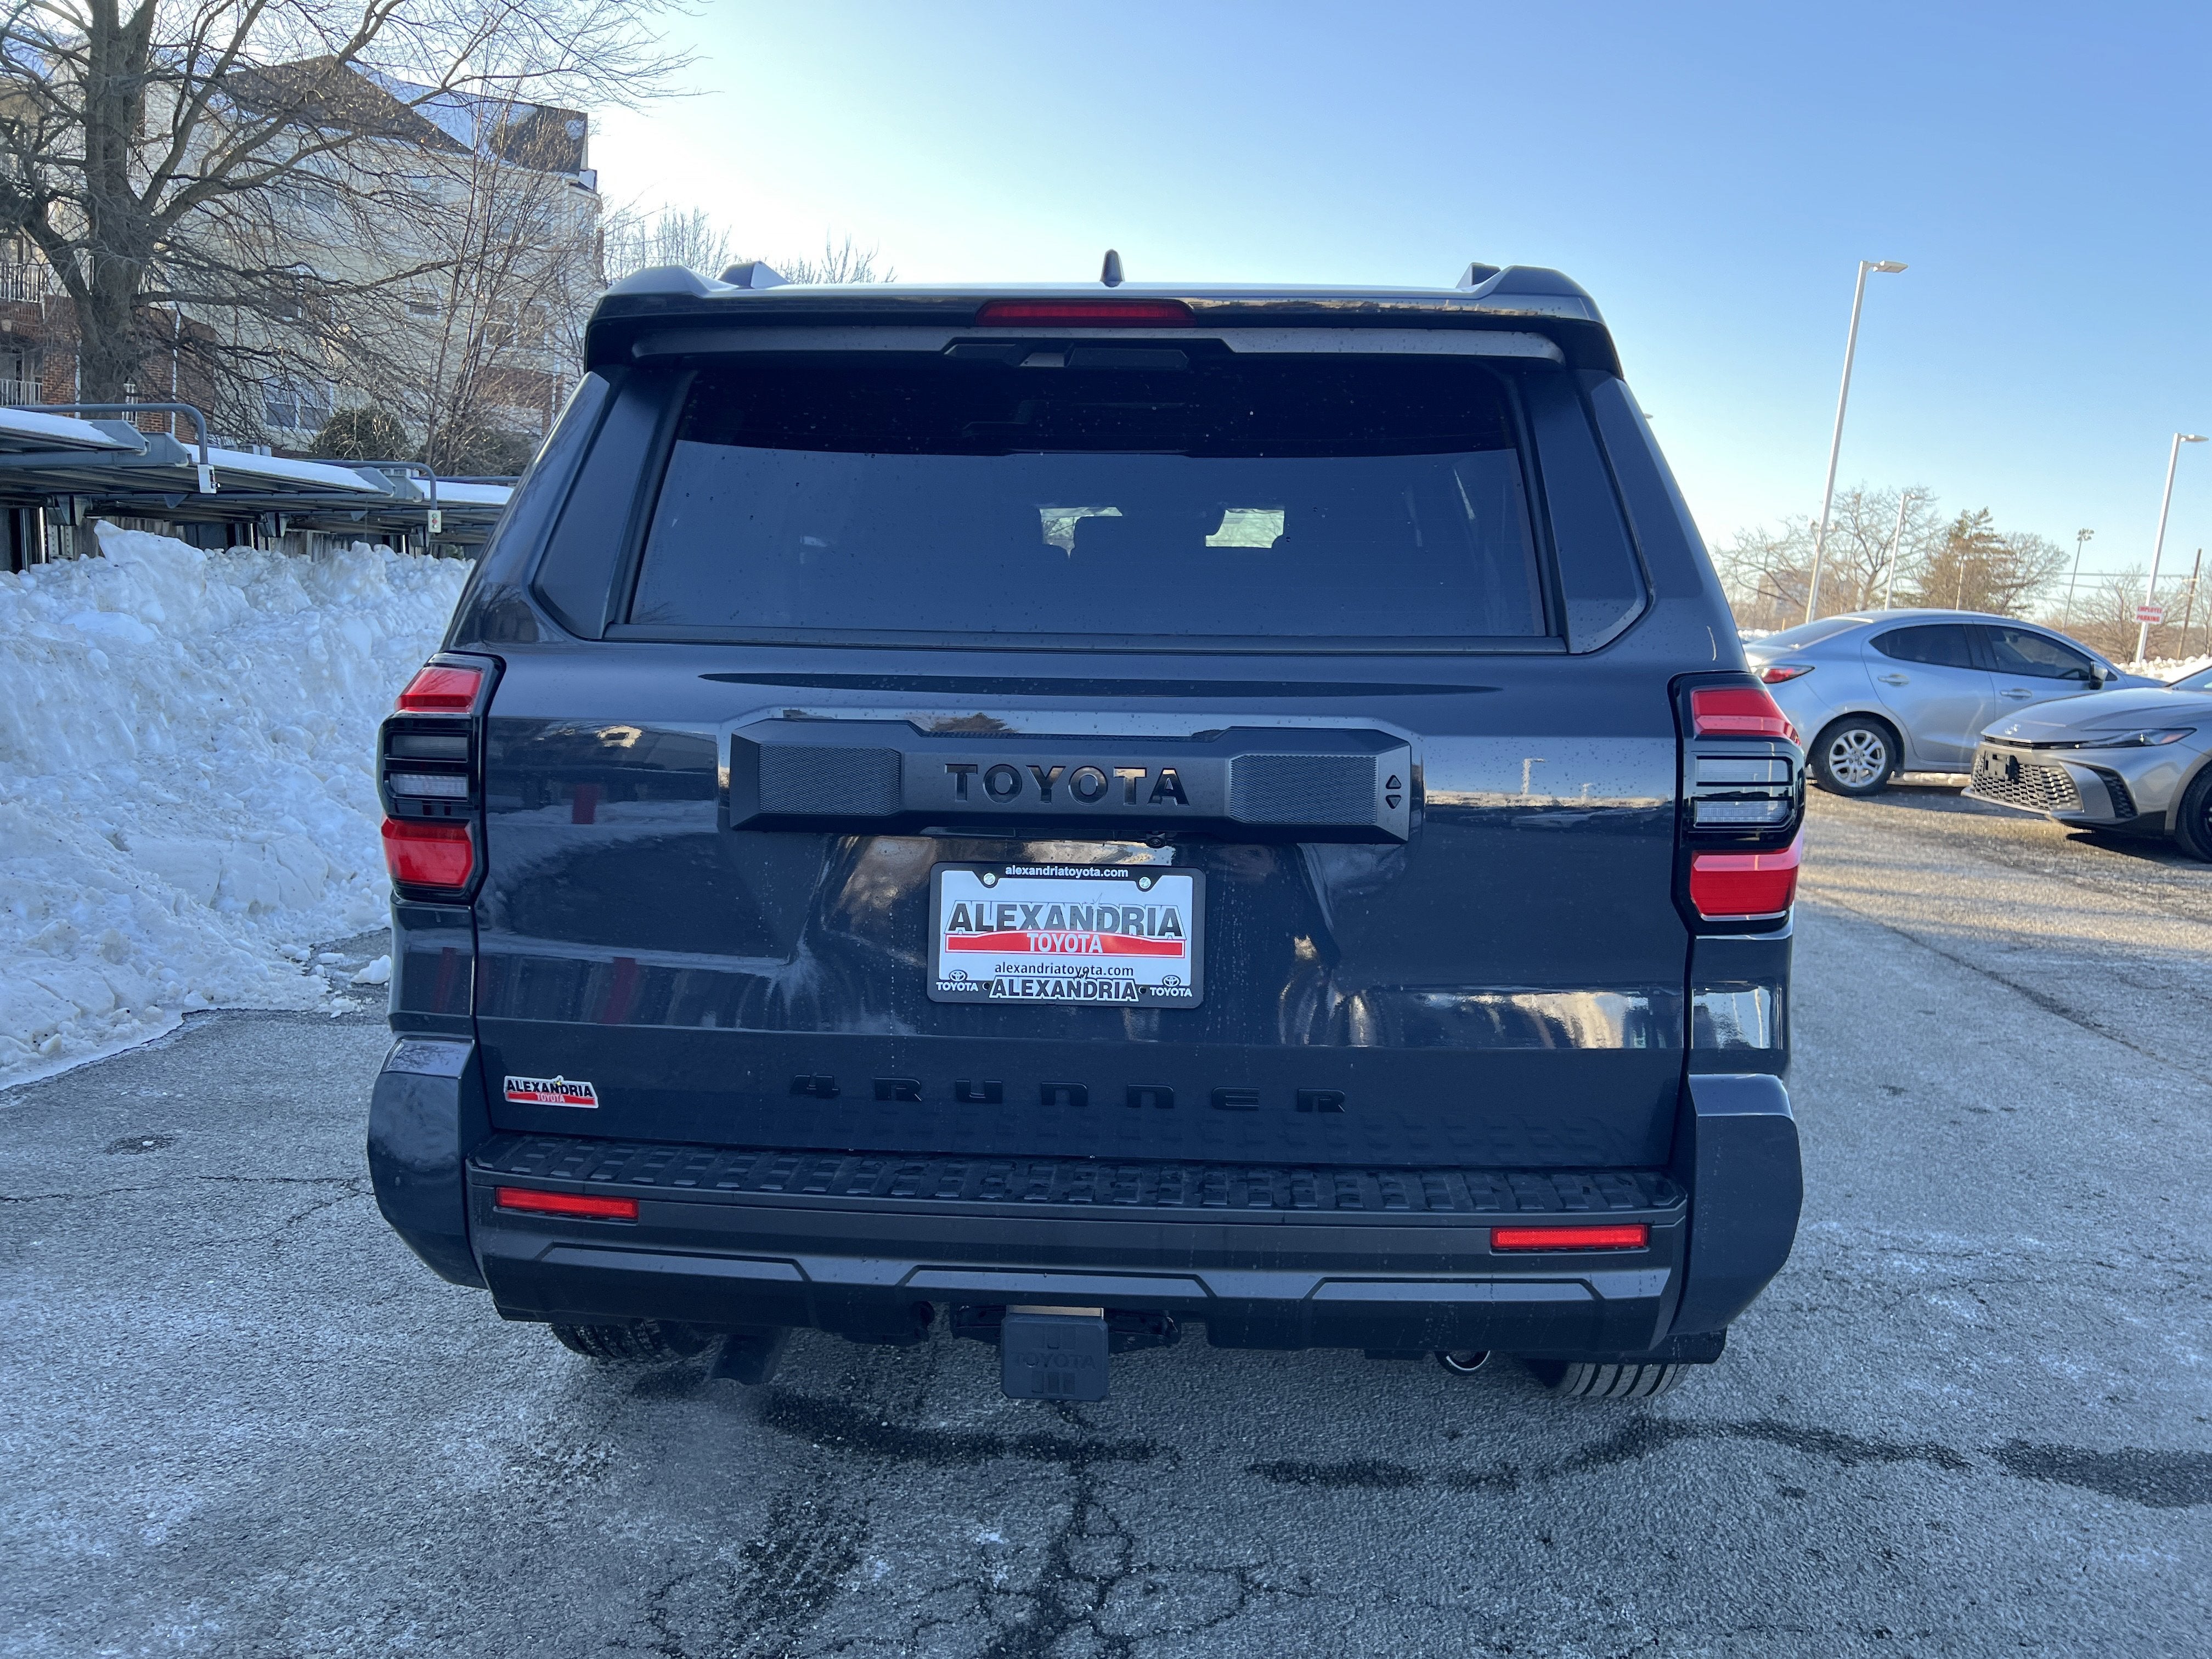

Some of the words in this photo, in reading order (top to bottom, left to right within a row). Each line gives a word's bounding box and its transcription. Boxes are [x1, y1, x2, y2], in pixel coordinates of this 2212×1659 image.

[944, 763, 1190, 806] TOYOTA
[1005, 865, 1128, 878] alexandriatoyota.com
[947, 902, 1183, 937] ALEXANDRIA
[1027, 933, 1103, 953] TOYOTA
[995, 962, 1134, 977] alexandriatoyota.com
[936, 982, 978, 992] TOYOTA
[991, 978, 1137, 1000] ALEXANDRIA
[1150, 987, 1193, 997] TOYOTA
[507, 1080, 593, 1097] ALEXANDRIA
[789, 1075, 1345, 1113] 4RUNNER
[536, 1093, 565, 1103] TOYOTA
[1012, 1352, 1097, 1370] TOYOTA
